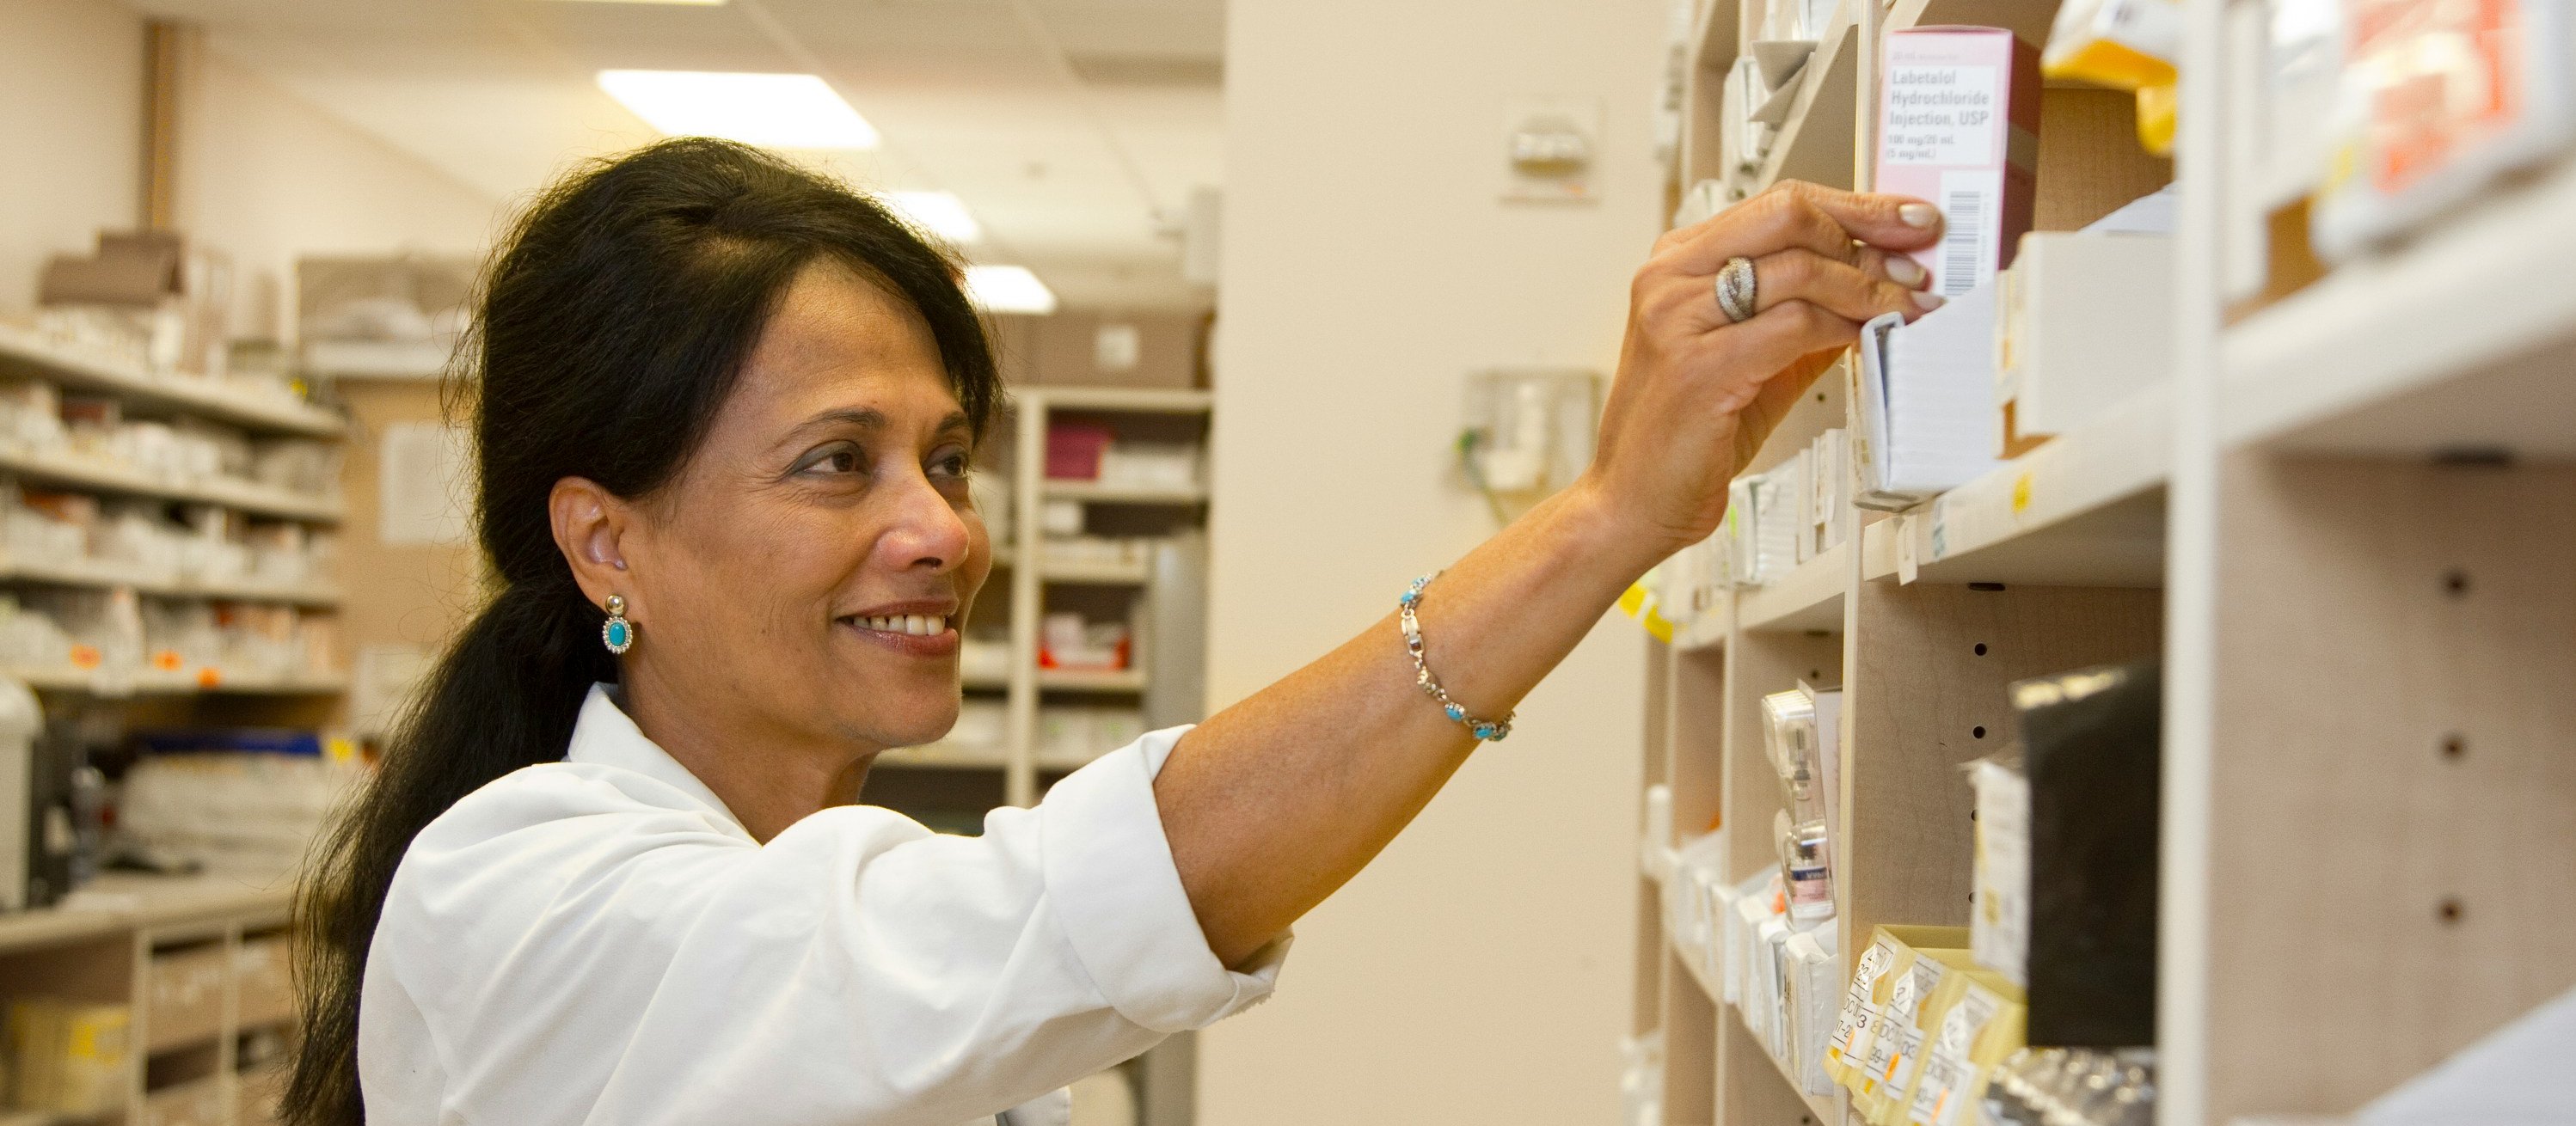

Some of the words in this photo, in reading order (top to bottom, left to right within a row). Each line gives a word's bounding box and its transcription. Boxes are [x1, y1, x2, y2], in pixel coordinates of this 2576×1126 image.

[1892, 70, 1956, 84] Labetalol
[1892, 90, 1989, 107] Hydrochloride
[1891, 110, 1954, 128] Injection,
[1960, 110, 1989, 125] USP
